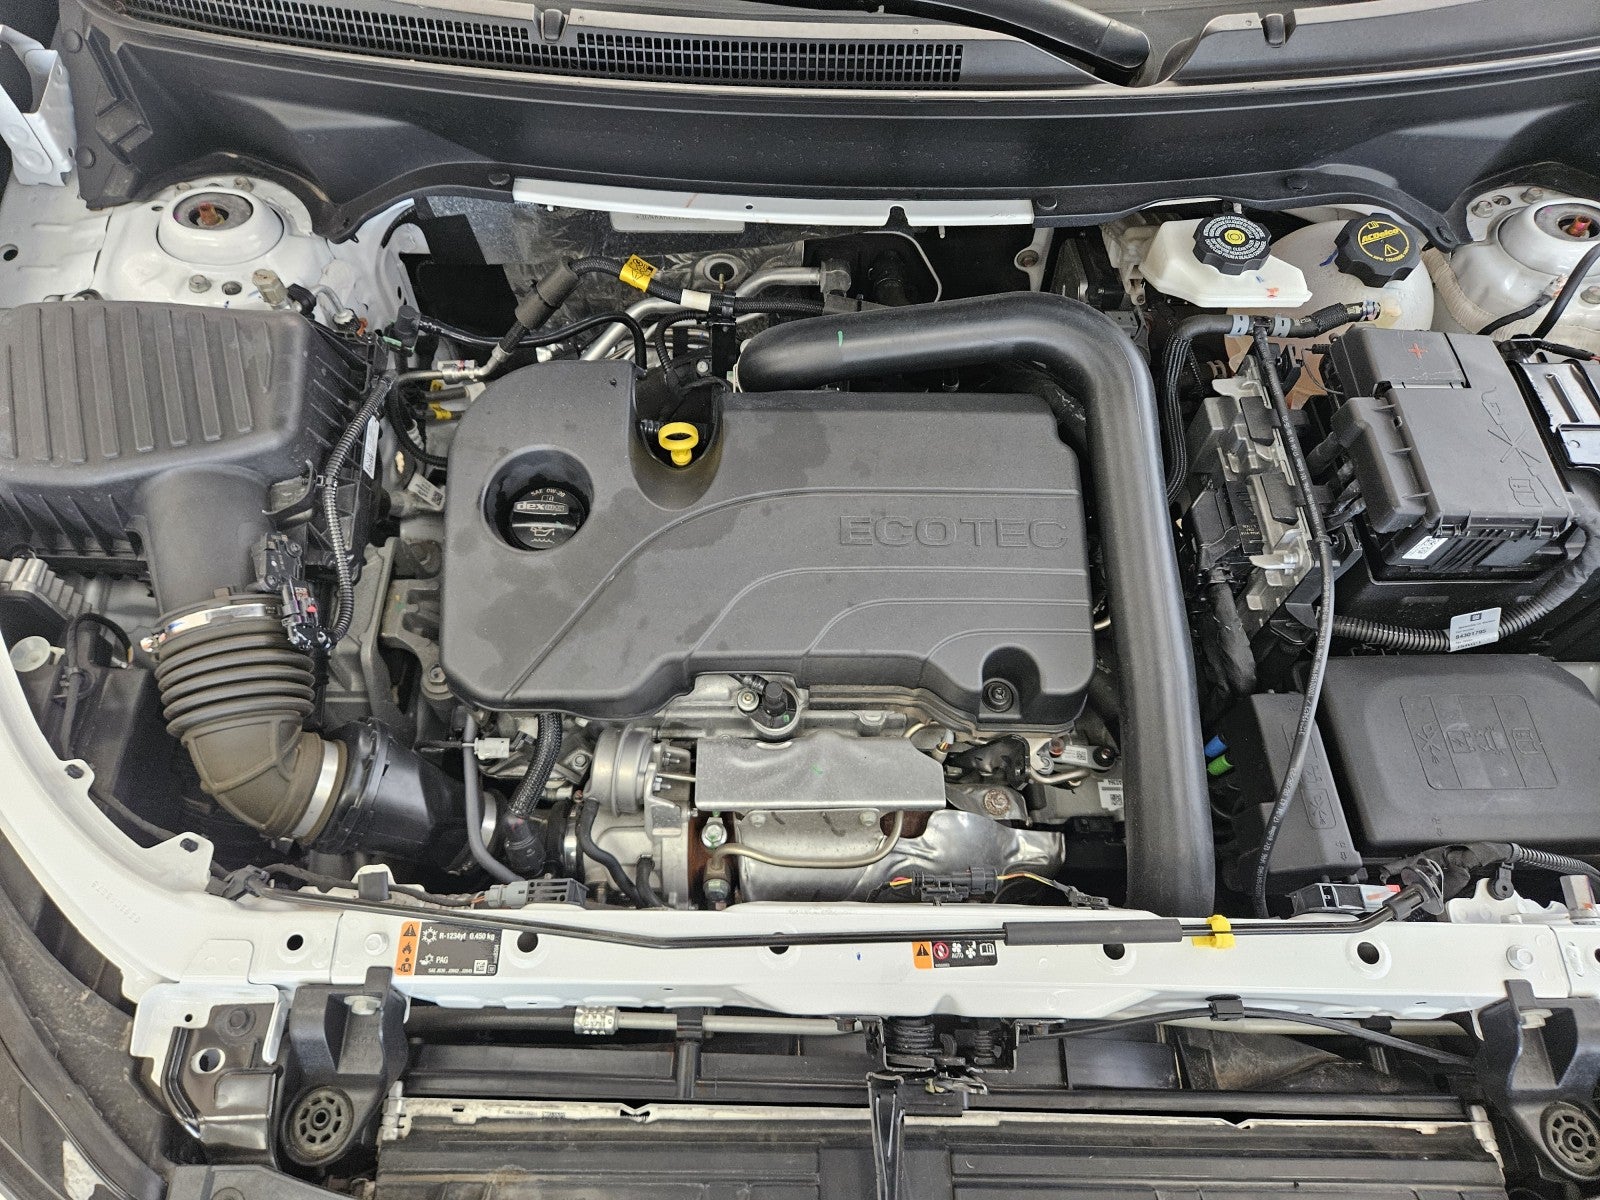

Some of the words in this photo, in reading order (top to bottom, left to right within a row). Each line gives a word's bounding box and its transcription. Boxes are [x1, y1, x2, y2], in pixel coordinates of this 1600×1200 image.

[1362, 228, 1400, 243] ACDelco
[839, 515, 1069, 548] ECOTEC
[469, 932, 487, 941] 0.450
[487, 932, 495, 941] kg
[435, 955, 449, 964] PAG
